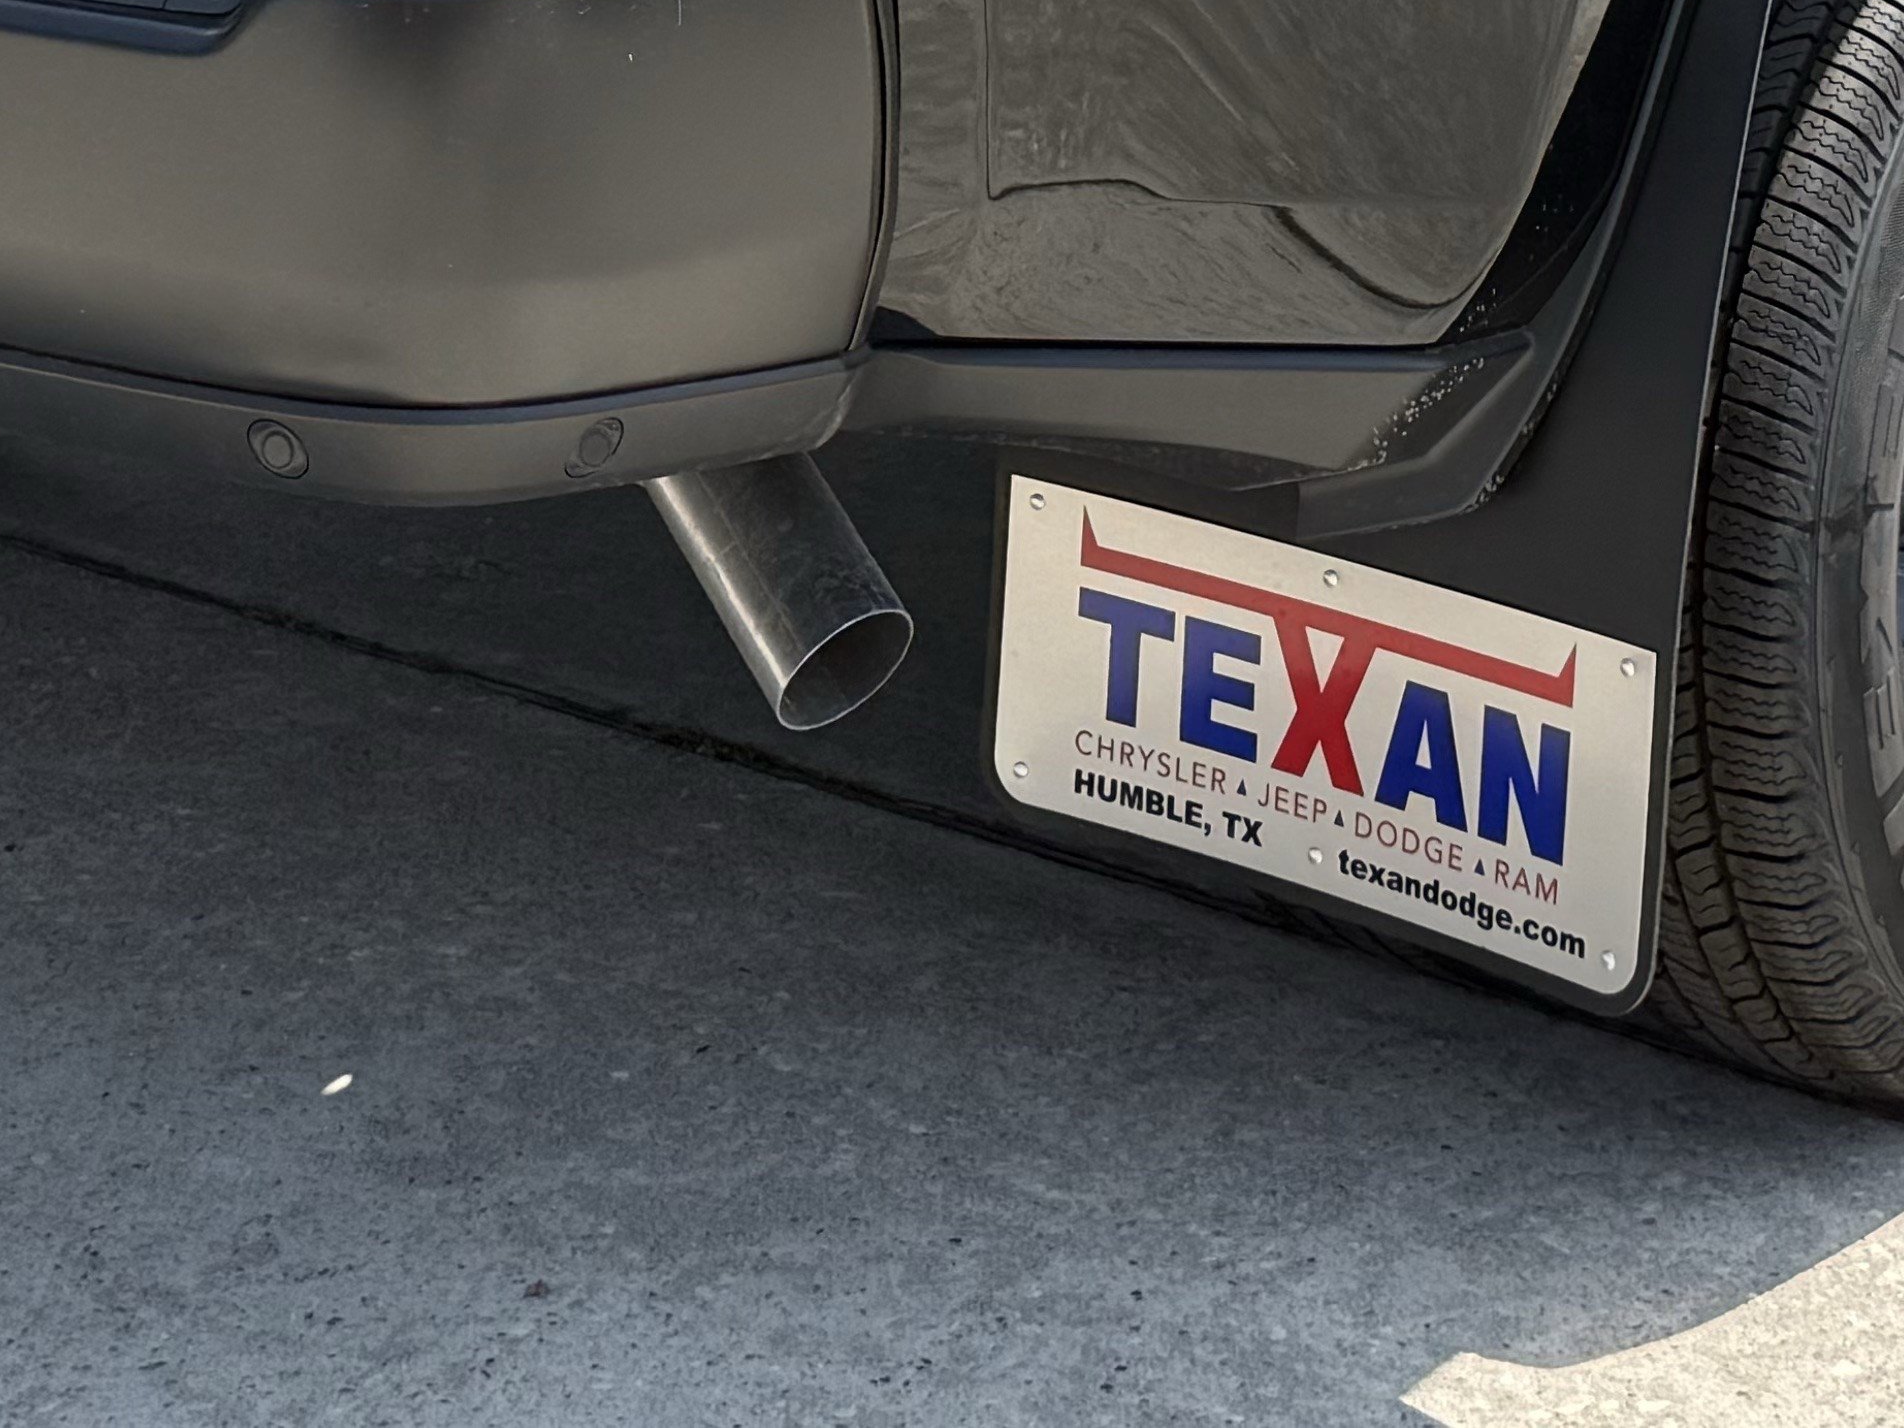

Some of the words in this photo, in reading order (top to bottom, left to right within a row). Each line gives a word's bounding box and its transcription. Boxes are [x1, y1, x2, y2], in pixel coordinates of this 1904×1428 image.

[1078, 505, 1577, 866] TEXAN
[1073, 768, 1213, 837] HUMBLE,
[1221, 810, 1264, 848] TX
[1074, 729, 1227, 795] CHRYSLER
[1257, 782, 1328, 824] JEEP
[1354, 811, 1464, 872] DODGE
[1494, 858, 1559, 906] RAM
[1337, 848, 1587, 960] texandodge.com
